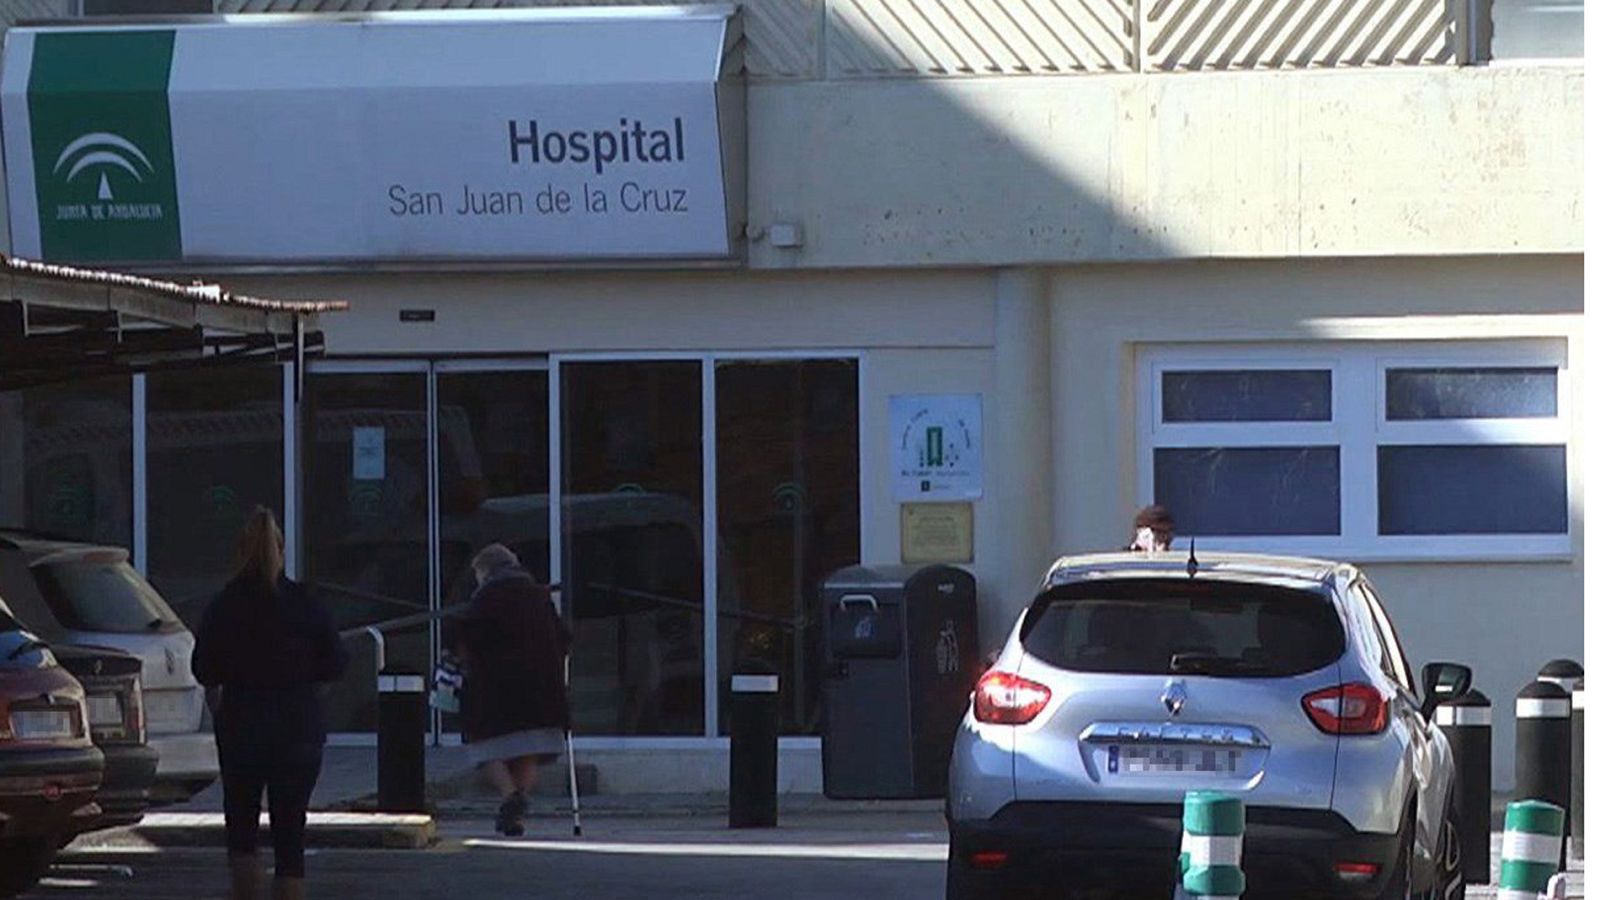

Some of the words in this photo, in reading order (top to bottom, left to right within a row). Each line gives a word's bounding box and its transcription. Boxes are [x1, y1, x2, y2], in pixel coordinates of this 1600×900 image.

[508, 117, 686, 174] Hospital
[388, 184, 444, 216] San
[456, 184, 524, 216] Juan
[535, 183, 571, 212] de
[584, 182, 608, 212] la
[620, 182, 689, 212] Cruz
